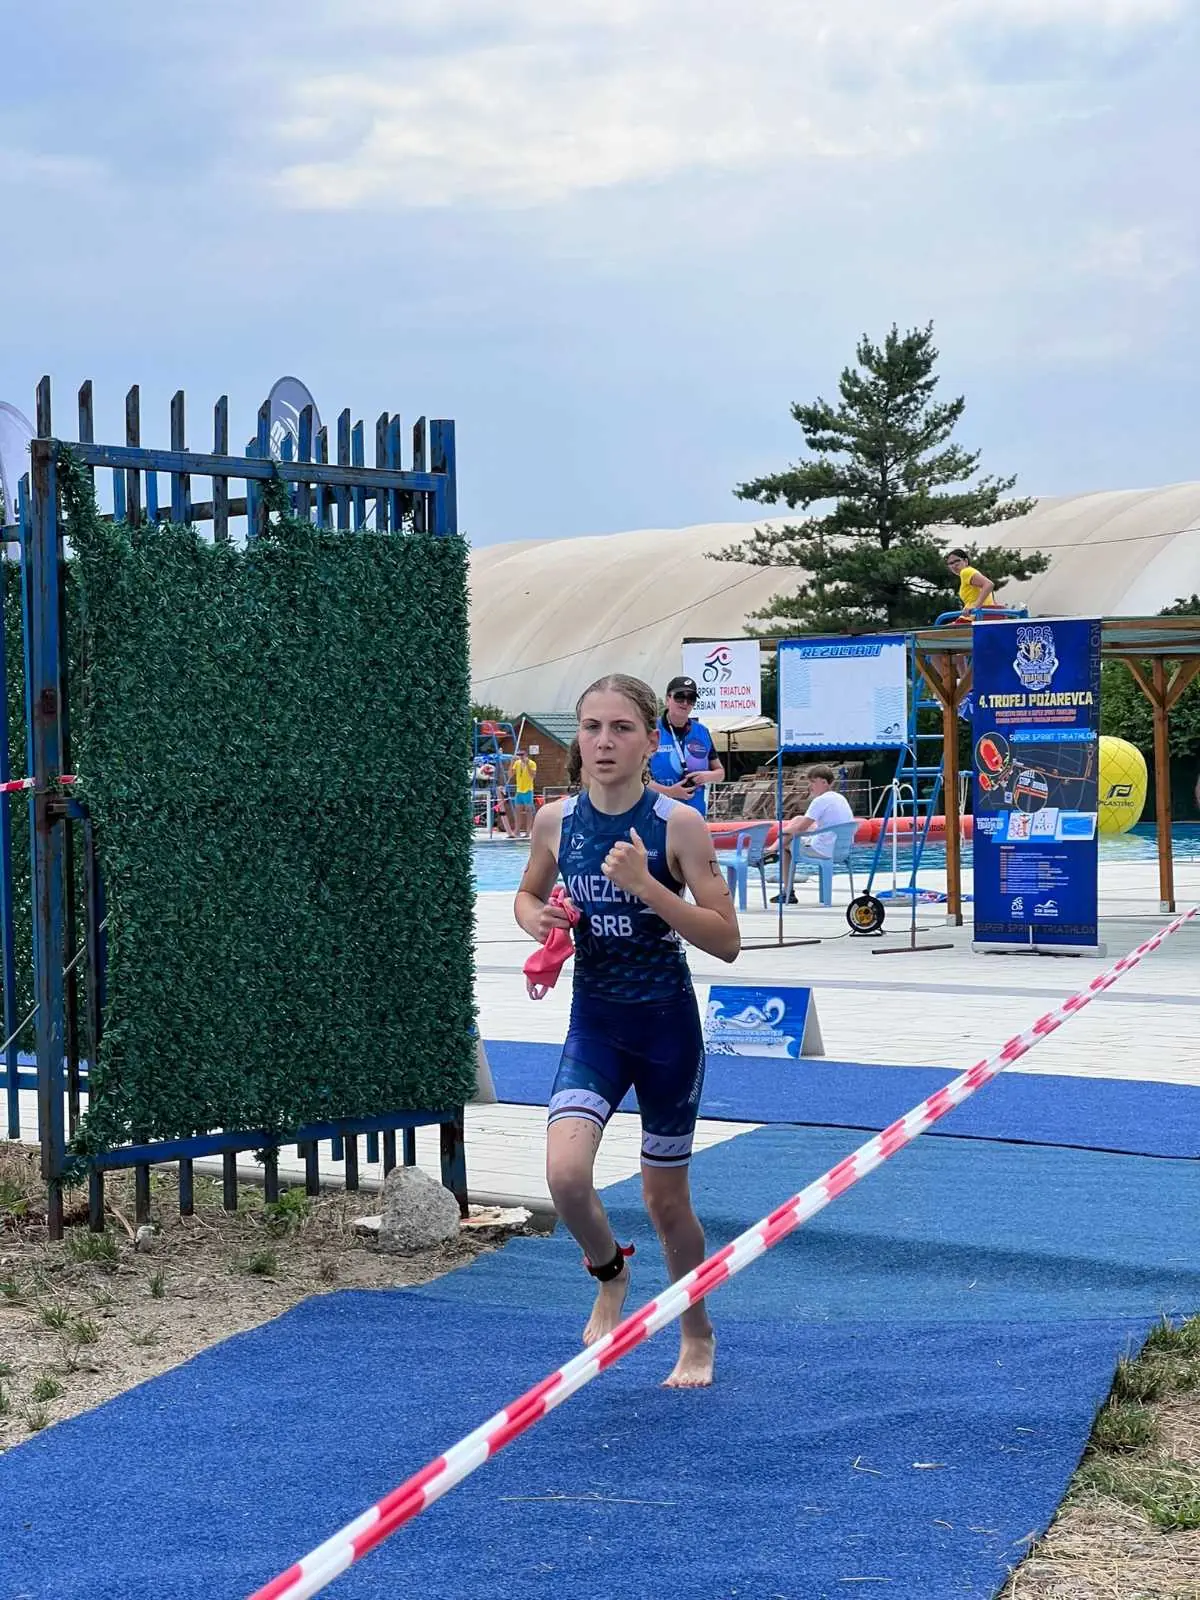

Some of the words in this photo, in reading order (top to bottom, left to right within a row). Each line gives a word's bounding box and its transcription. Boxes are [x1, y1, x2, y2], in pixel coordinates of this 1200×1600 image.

[801, 644, 881, 657] REZULTATI
[696, 687, 715, 697] RPSKI
[720, 686, 751, 696] TRIATLON
[720, 700, 756, 710] TRIATHLON
[979, 695, 988, 708] 4.
[989, 694, 1026, 708] TROFEJ
[1028, 690, 1093, 707] POŽAREVCA
[590, 914, 633, 937] SRB
